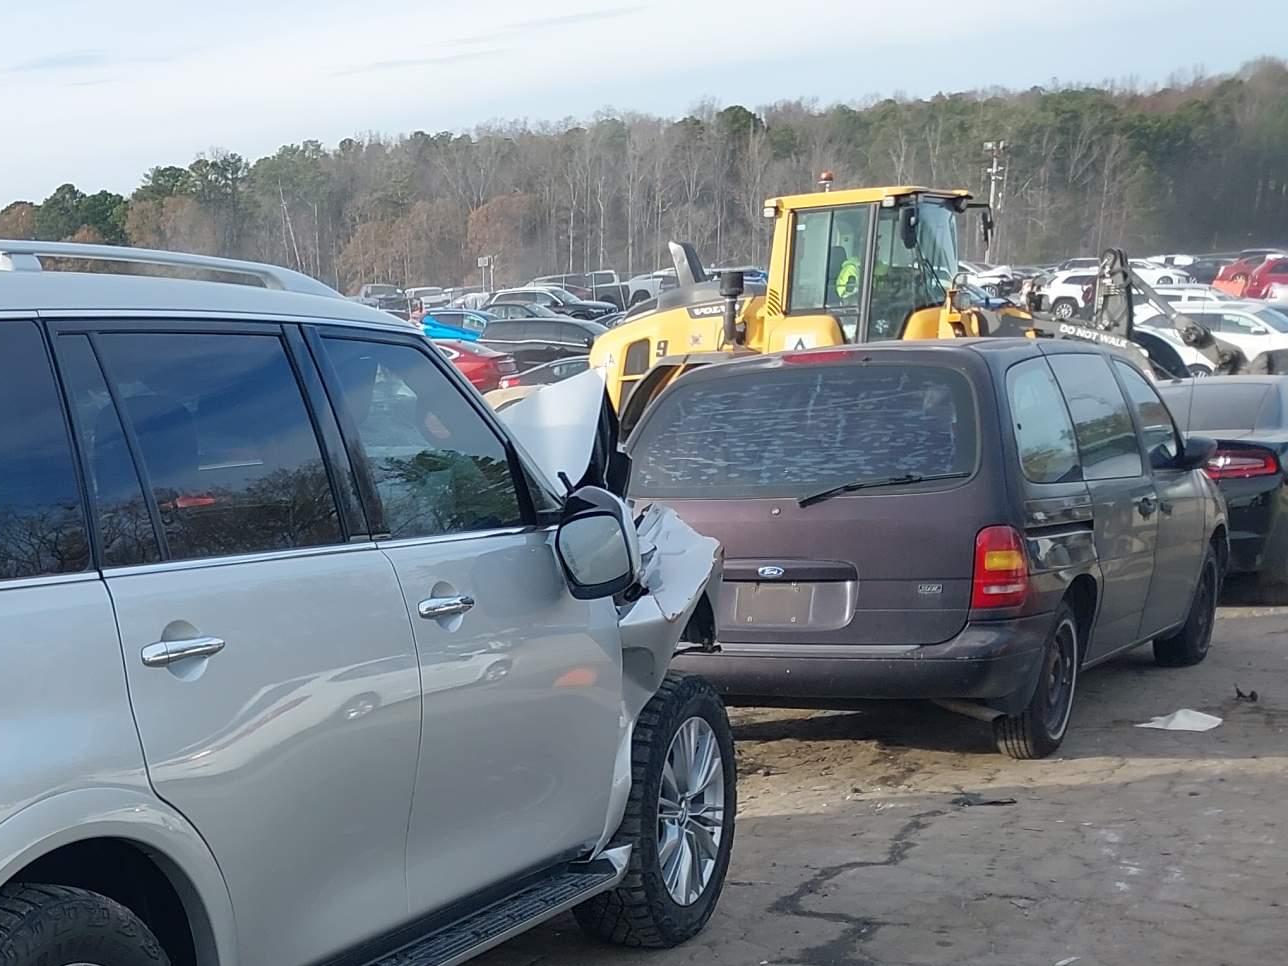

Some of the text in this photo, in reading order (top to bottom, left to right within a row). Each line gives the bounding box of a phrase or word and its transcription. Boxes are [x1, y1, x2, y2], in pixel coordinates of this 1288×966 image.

[1060, 324, 1127, 348] DO NOT WALK
